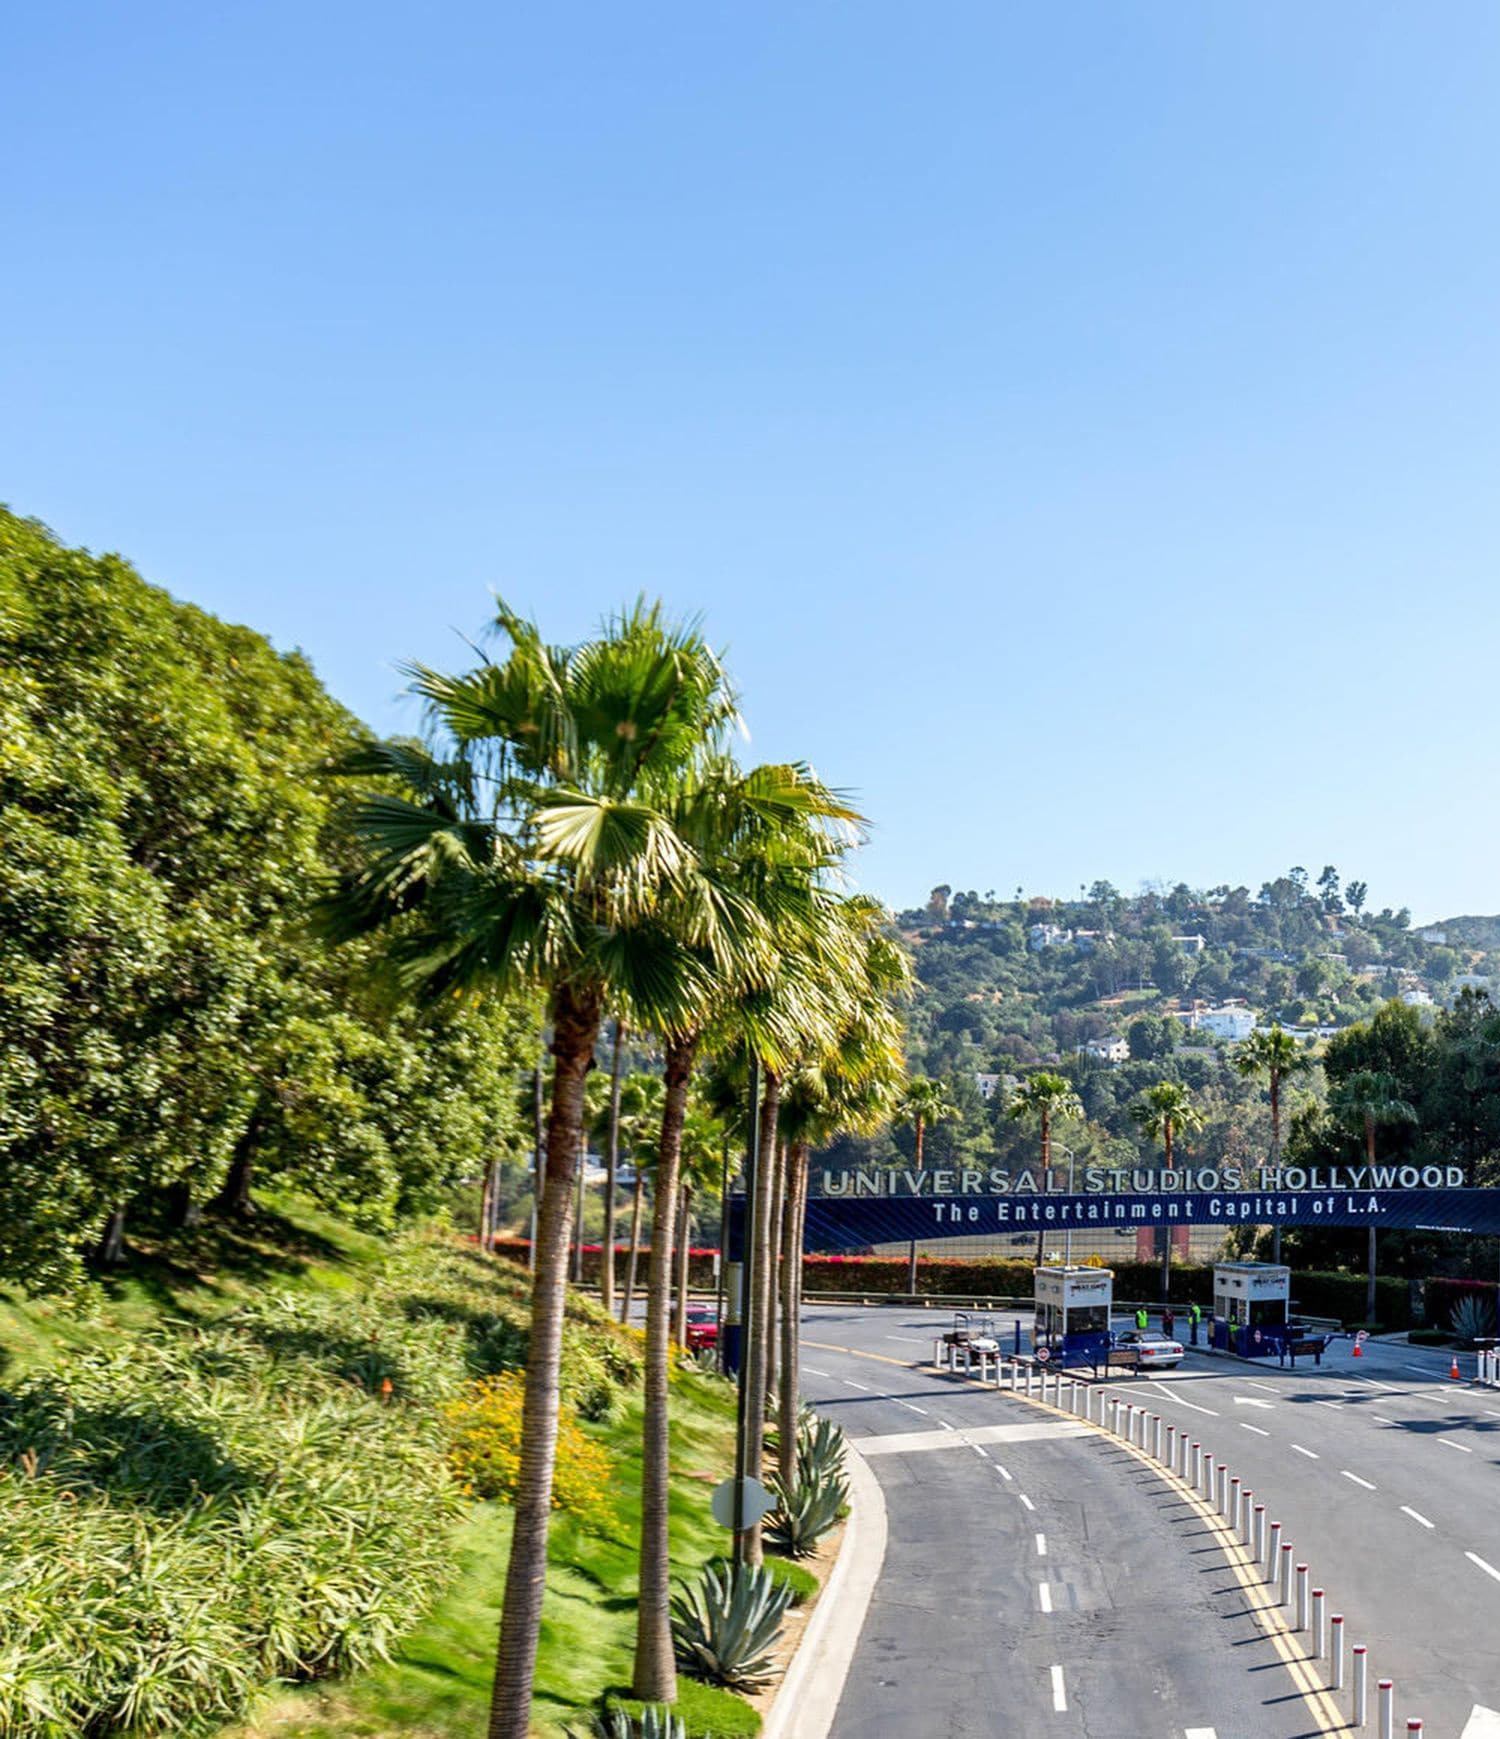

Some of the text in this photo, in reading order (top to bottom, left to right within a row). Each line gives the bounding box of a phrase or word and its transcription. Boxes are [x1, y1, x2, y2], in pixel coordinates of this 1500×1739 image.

[821, 1166, 1464, 1196] UNIVERSAL STUDIOS HOLLYWOOD
[933, 1197, 1387, 1222] The Entertainment Capital of L.A.
